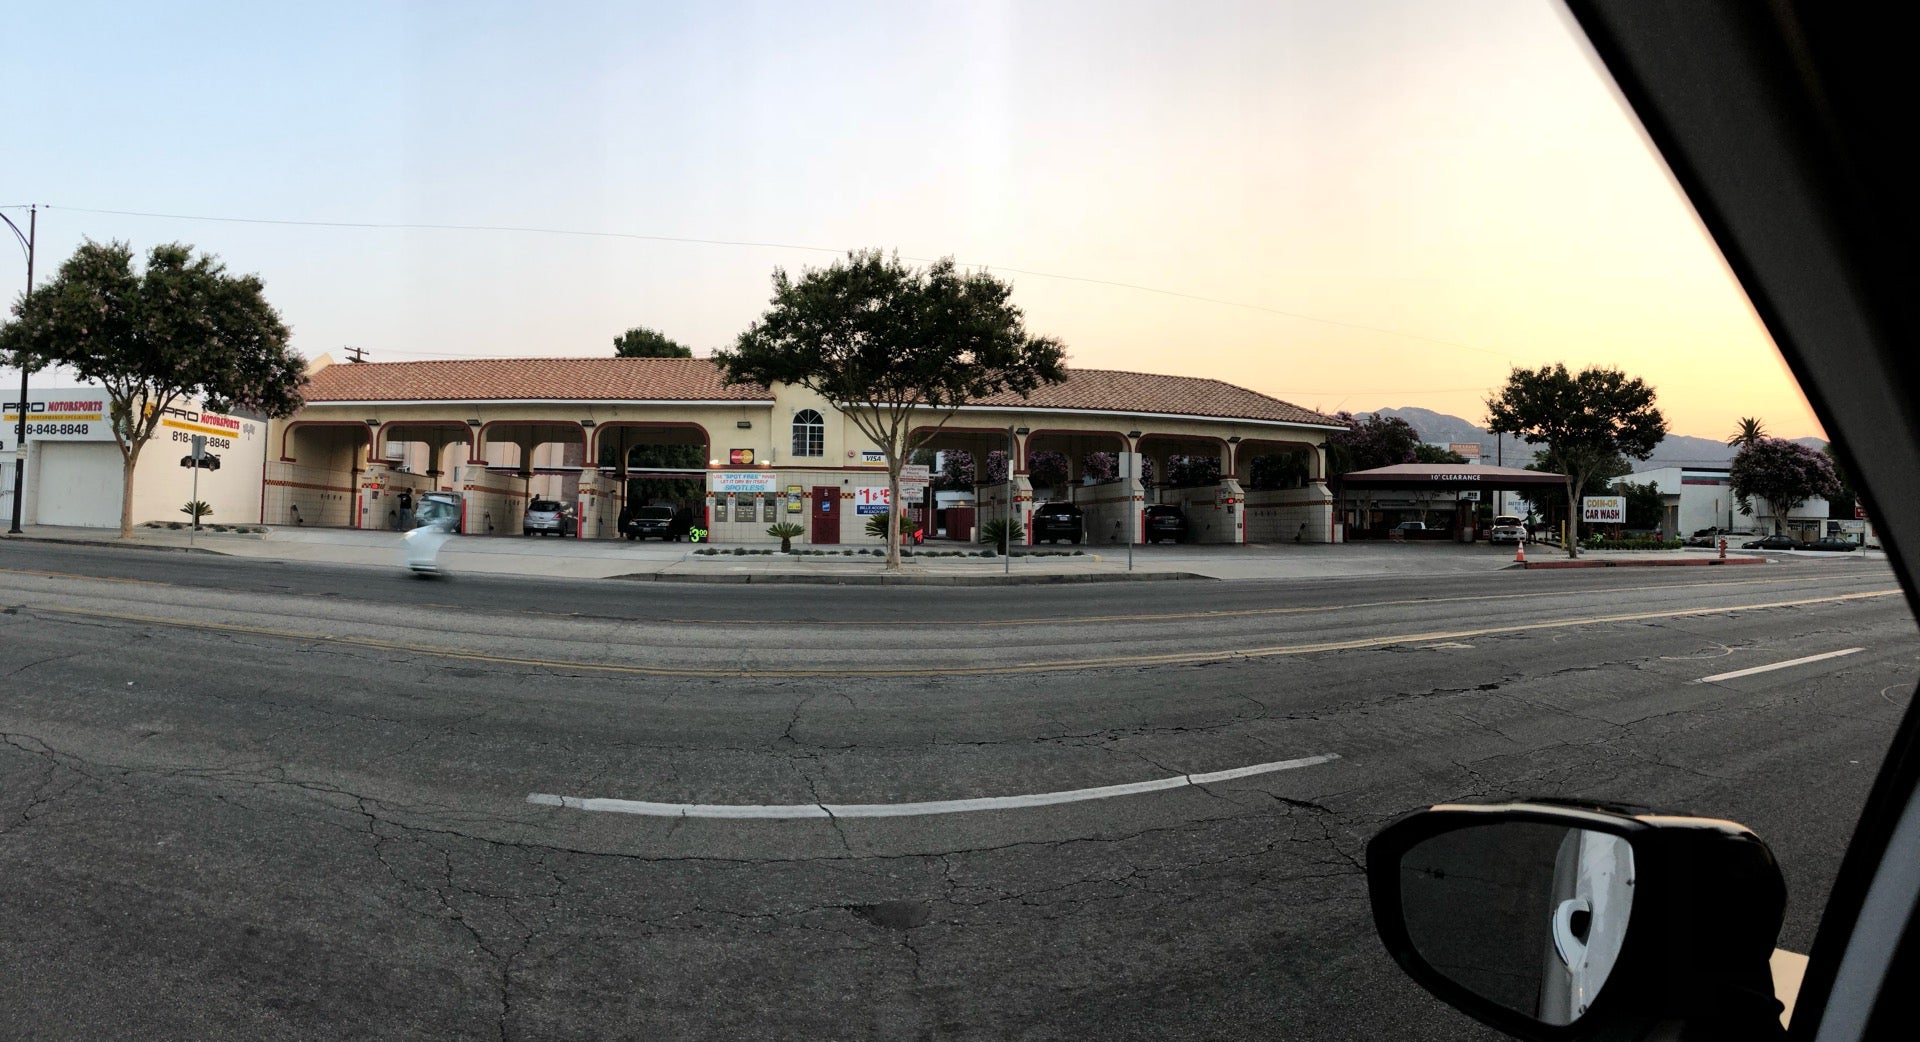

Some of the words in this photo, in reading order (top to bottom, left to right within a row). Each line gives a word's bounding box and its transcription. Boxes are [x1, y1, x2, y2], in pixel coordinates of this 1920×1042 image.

[47, 401, 103, 412] MOTORSPORTS
[162, 406, 199, 422] PRO
[200, 413, 240, 430] MOTORSPORTS
[14, 424, 89, 435] 88-848-8848
[172, 431, 231, 449] 818--8848
[858, 488, 870, 504] $1
[1585, 509, 1599, 520] CAR
[1599, 509, 1620, 520] WASH
